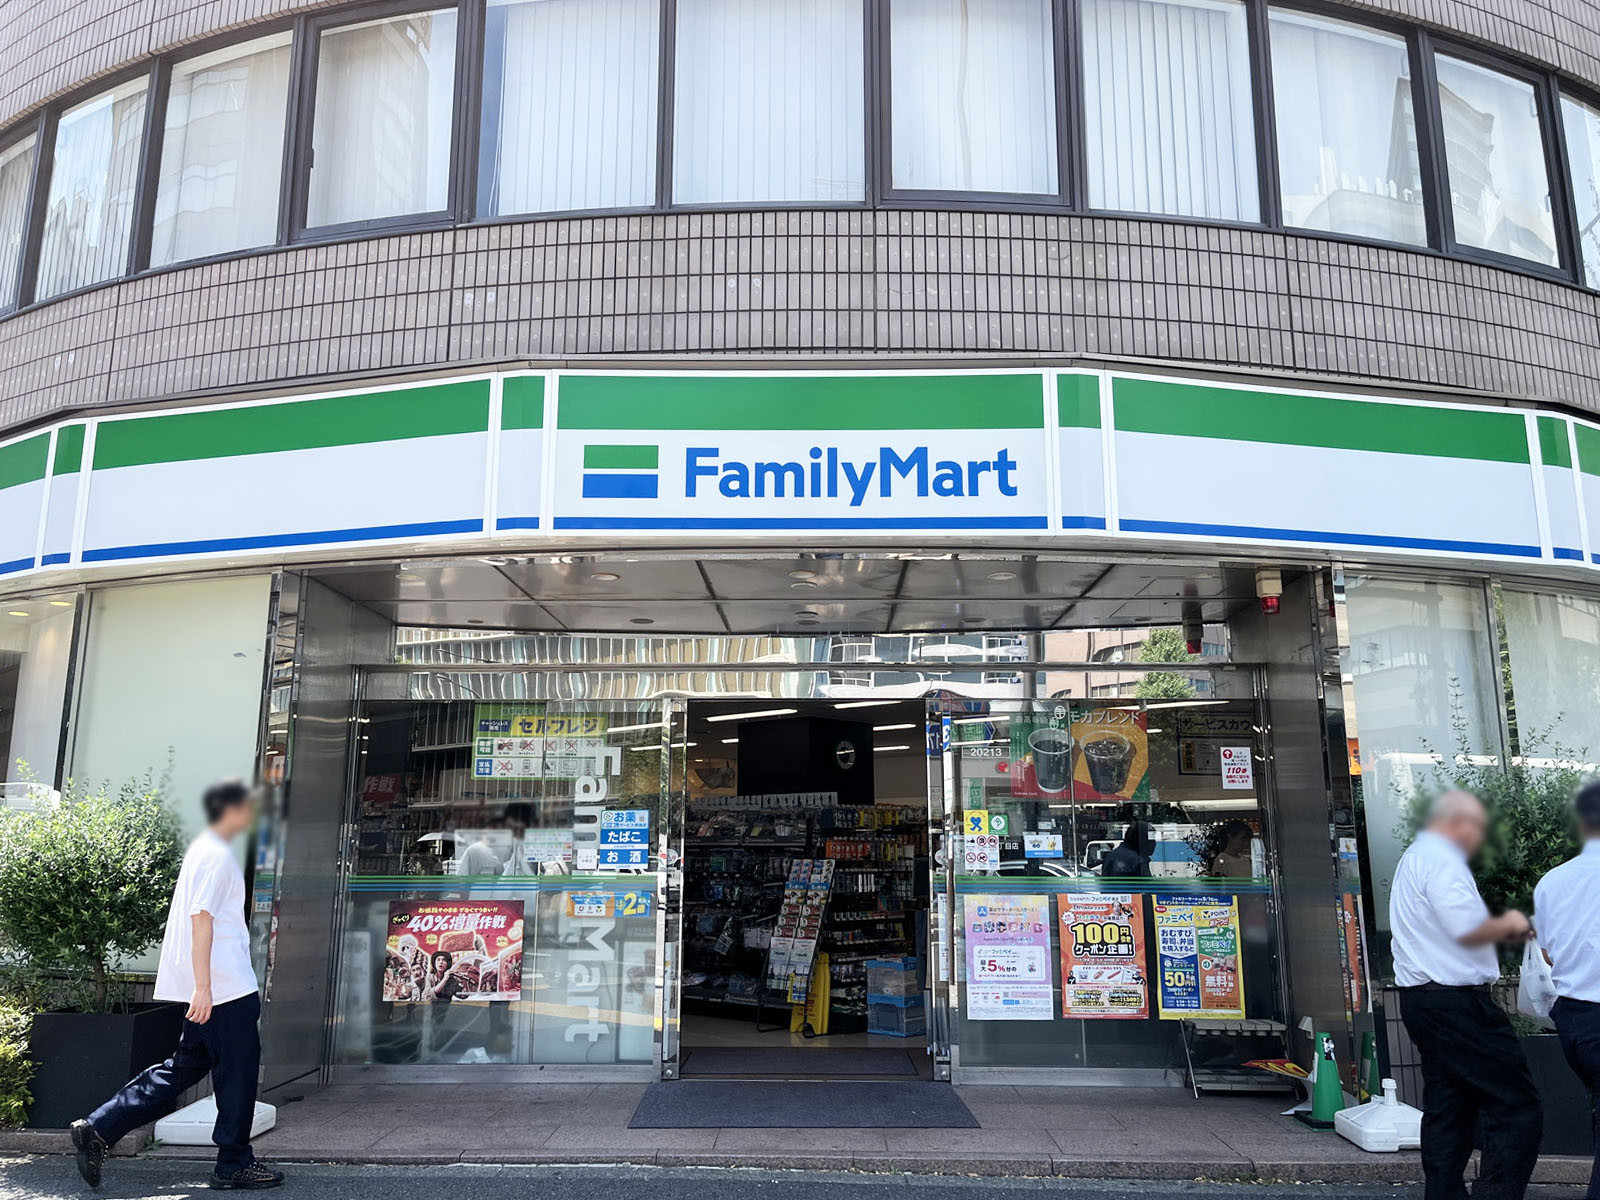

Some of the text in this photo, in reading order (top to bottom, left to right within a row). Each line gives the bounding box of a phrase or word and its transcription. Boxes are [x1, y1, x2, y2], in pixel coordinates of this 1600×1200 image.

[685, 447, 1018, 507] FamilyMart
[1070, 710, 1140, 725] モカブレンド
[519, 718, 598, 735] セルフレジ
[970, 747, 1002, 757] 20213
[614, 811, 636, 822] お薬
[607, 830, 641, 843] たばこ
[607, 851, 618, 863] お
[629, 851, 641, 863] 酒
[406, 913, 507, 932] 40%増量作戦
[1157, 913, 1194, 924] ファミペイ
